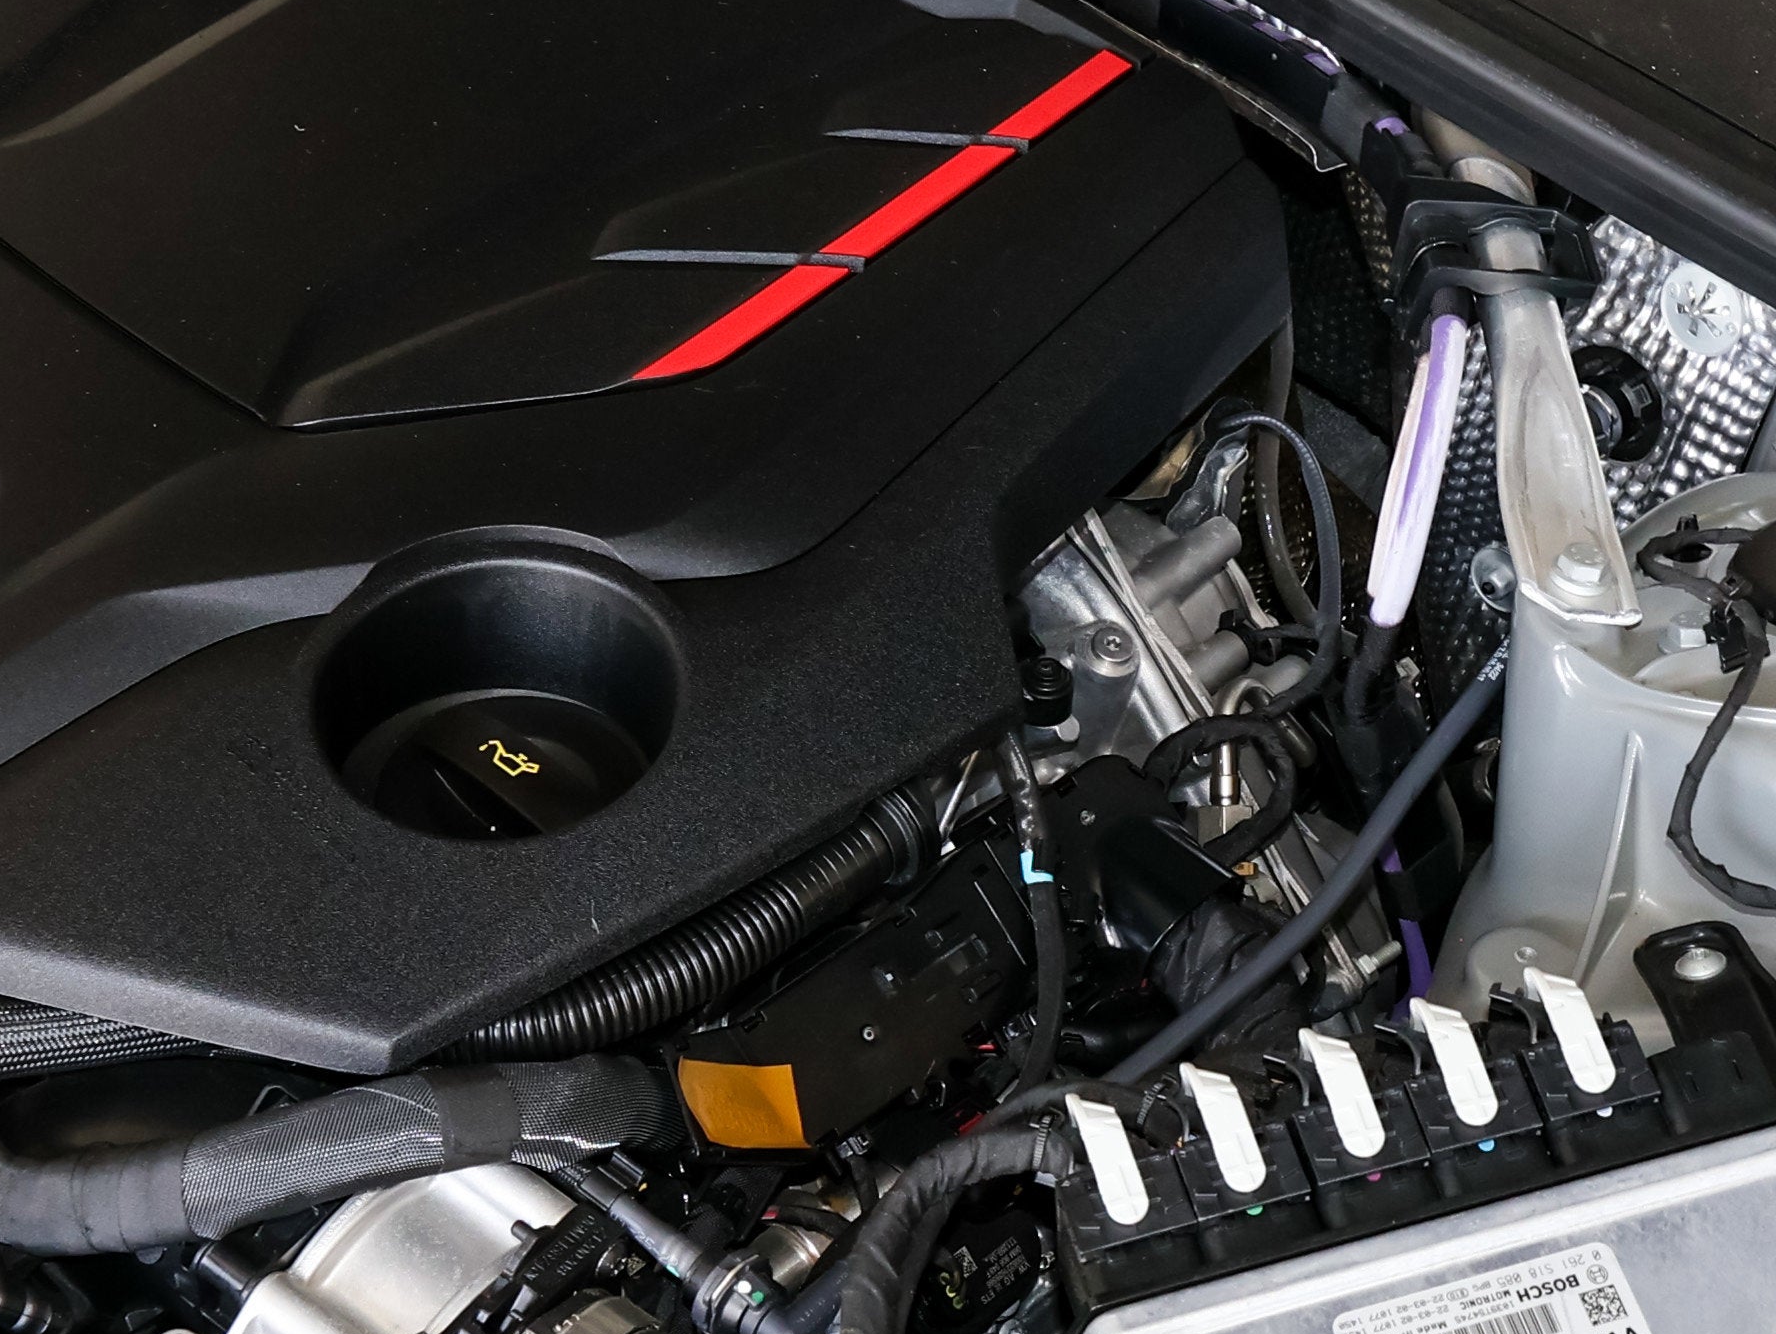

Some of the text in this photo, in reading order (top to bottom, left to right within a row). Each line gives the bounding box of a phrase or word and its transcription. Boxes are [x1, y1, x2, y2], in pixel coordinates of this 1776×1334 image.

[1526, 1261, 1554, 1279] S18
[1560, 1253, 1586, 1270] 261
[1494, 1271, 1523, 1288] 085
[1514, 1273, 1580, 1303] BOSCH
[1458, 1288, 1512, 1310] MOTRONIC
[1398, 1303, 1450, 1326] 22-03-02
[1414, 1319, 1448, 1334] Made
